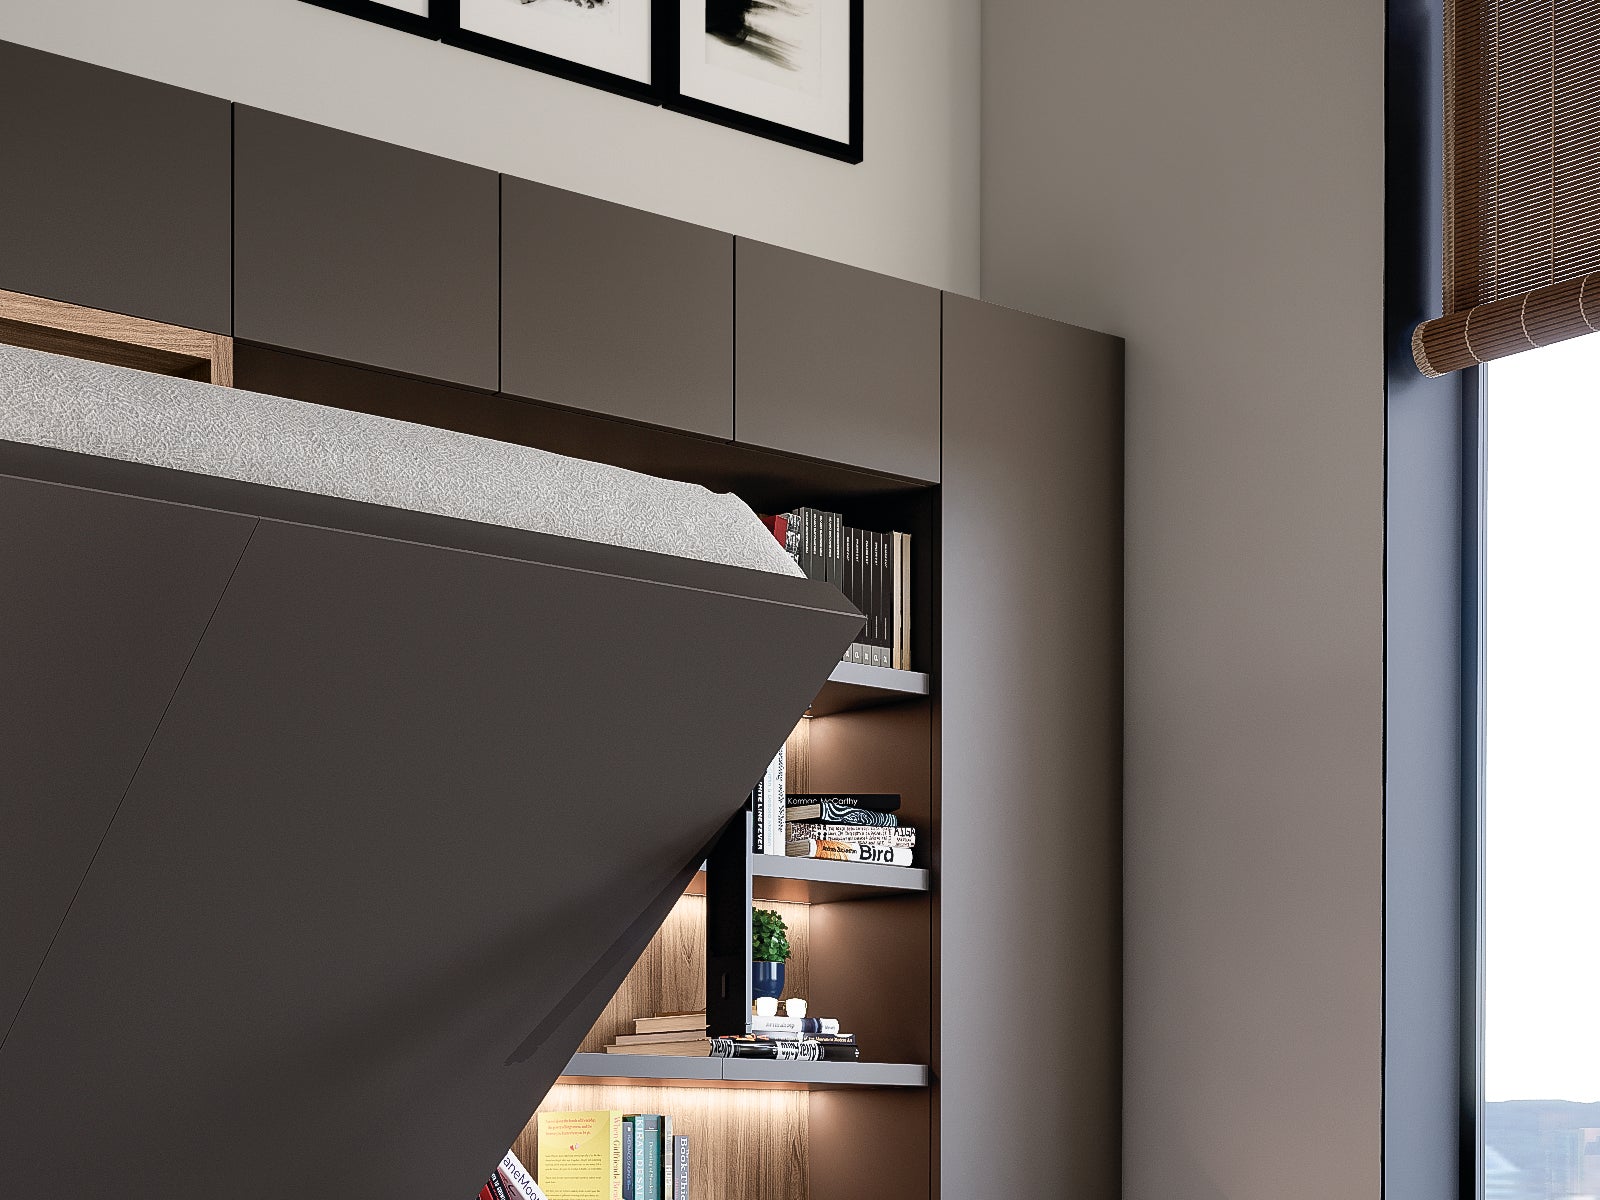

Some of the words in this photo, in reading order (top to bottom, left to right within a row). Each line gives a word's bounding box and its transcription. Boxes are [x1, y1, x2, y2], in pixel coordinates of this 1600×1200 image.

[859, 844, 894, 863] Bird
[636, 1119, 644, 1158] KIRAN
[612, 1139, 620, 1179] Girlfriends
[636, 1159, 644, 1196] DESAI
